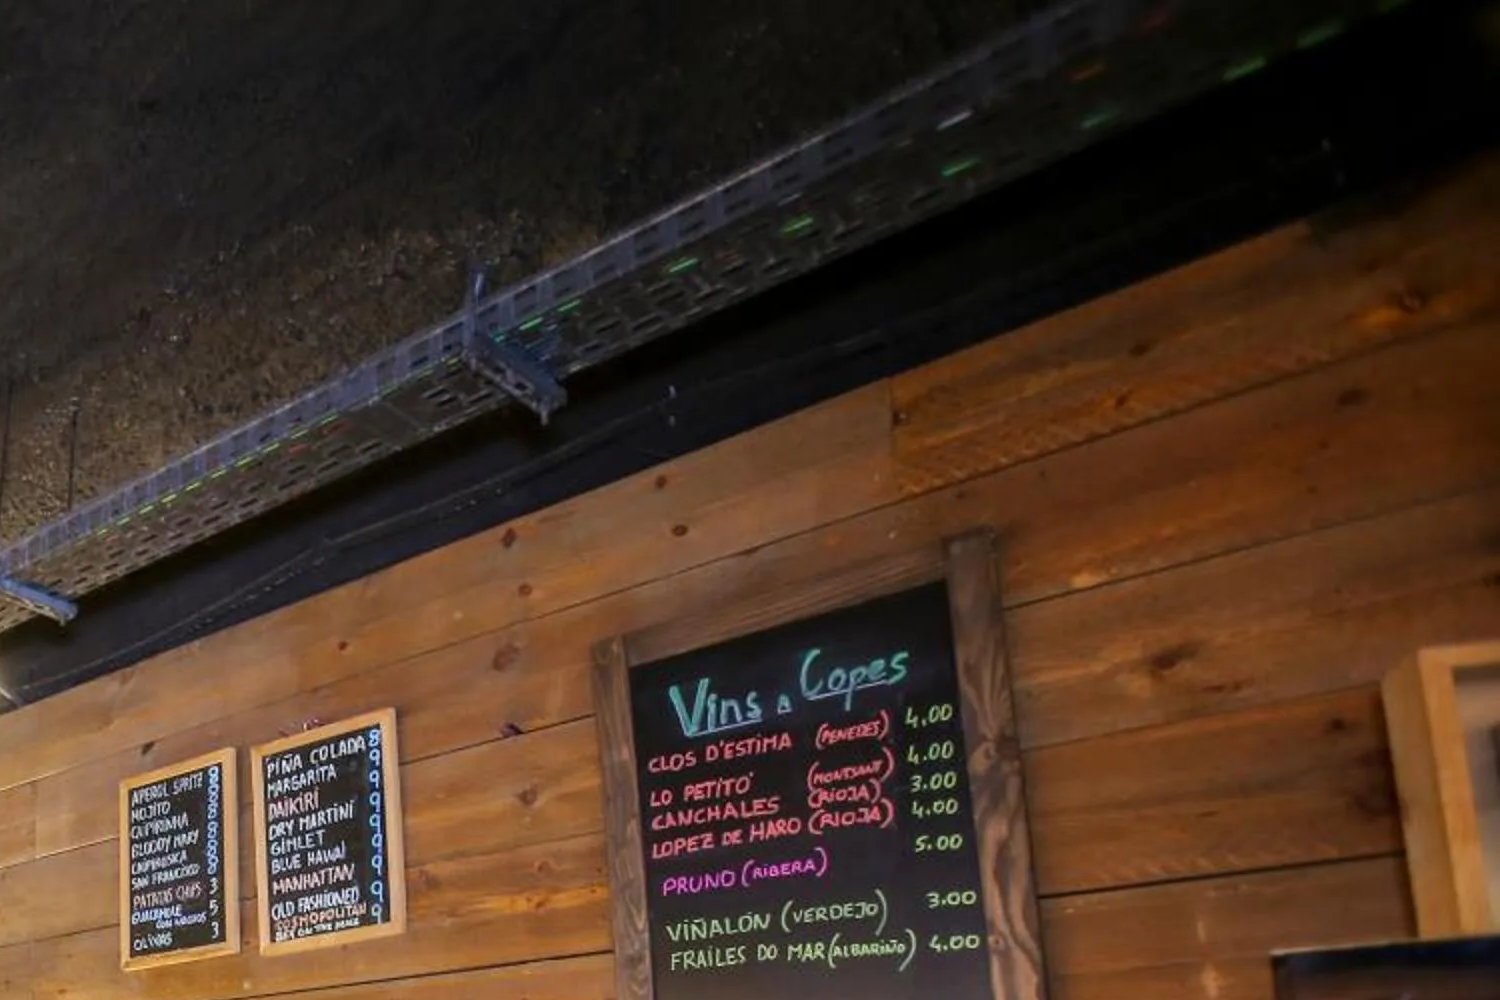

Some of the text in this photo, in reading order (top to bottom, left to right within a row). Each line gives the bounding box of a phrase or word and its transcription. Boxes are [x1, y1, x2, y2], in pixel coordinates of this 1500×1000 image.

[668, 677, 763, 737] Vins
[800, 648, 909, 711] Copes
[267, 753, 303, 779] PIÑA
[309, 735, 366, 765] COLADA
[648, 751, 697, 773] CLOS
[905, 703, 952, 729] 4.00
[267, 749, 380, 799] MARGARITA 9
[650, 789, 673, 807] LO
[907, 740, 955, 765] 4.00
[132, 801, 171, 823] MOJITO
[268, 770, 380, 822] DAIKIRI 9
[269, 792, 381, 841] DRY MARTINI 9
[652, 796, 781, 831] CANCHALES
[910, 771, 957, 793] 3.00
[271, 814, 381, 856] GIMLET 9
[652, 833, 715, 860] LOPEZ
[721, 829, 743, 846] DE
[749, 817, 802, 843] HARO
[912, 799, 959, 819] 4.00
[272, 854, 300, 874] BLUE
[371, 833, 383, 852] 9
[273, 854, 383, 895] MANHATTAN 9
[663, 834, 963, 896] PRUNO (RIBERA) 5.00
[209, 877, 219, 894] 3
[209, 899, 219, 916] 5
[271, 881, 383, 922] OLD FASHIONED 9
[211, 922, 219, 939] 3
[274, 902, 382, 931] COSMOPOLITAN 9
[781, 889, 887, 936] (VERDEJO)
[926, 891, 977, 909] 3.00
[671, 945, 747, 971] FRAILES
[757, 944, 778, 961] DO
[787, 942, 825, 963] MAR
[929, 935, 980, 953] 4.00
